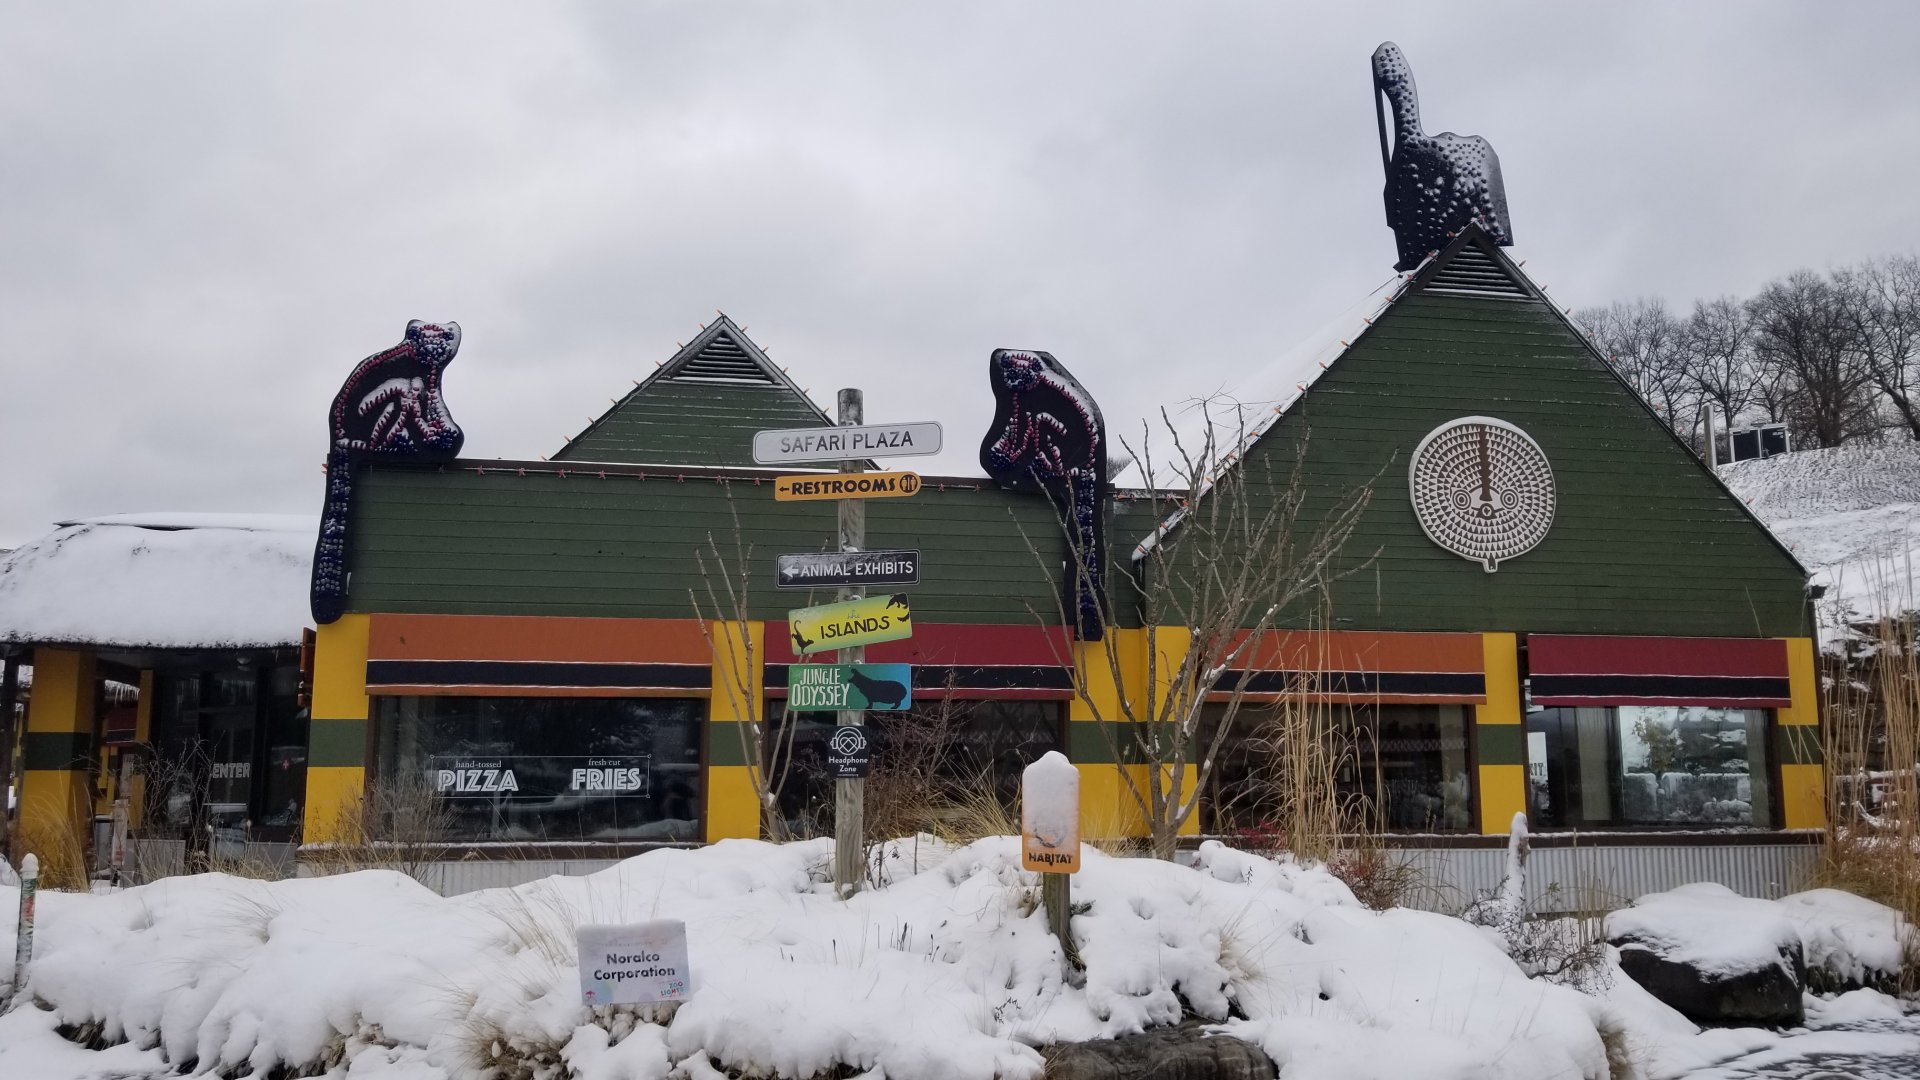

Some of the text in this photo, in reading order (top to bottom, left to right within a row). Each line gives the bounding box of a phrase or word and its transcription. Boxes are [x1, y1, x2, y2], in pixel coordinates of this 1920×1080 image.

[780, 431, 914, 453] SAFARI PLAZA
[791, 478, 896, 495] RESTROOMS
[800, 561, 914, 577] ANIMAL EXHIBITS
[820, 615, 890, 639] ISLANDS
[800, 668, 841, 685] JUNGLE
[791, 683, 850, 706] ODYSSEY
[455, 760, 502, 768] hand-tossed
[588, 758, 607, 766] fresh
[828, 756, 869, 766] Headphone
[839, 764, 857, 772] Zone
[213, 763, 250, 778] ENTER
[437, 769, 519, 792] PIZZA
[571, 767, 642, 791] FRIES
[1028, 852, 1073, 864] HABITAT
[606, 950, 661, 965] Noralco
[593, 966, 676, 983] Corporation
